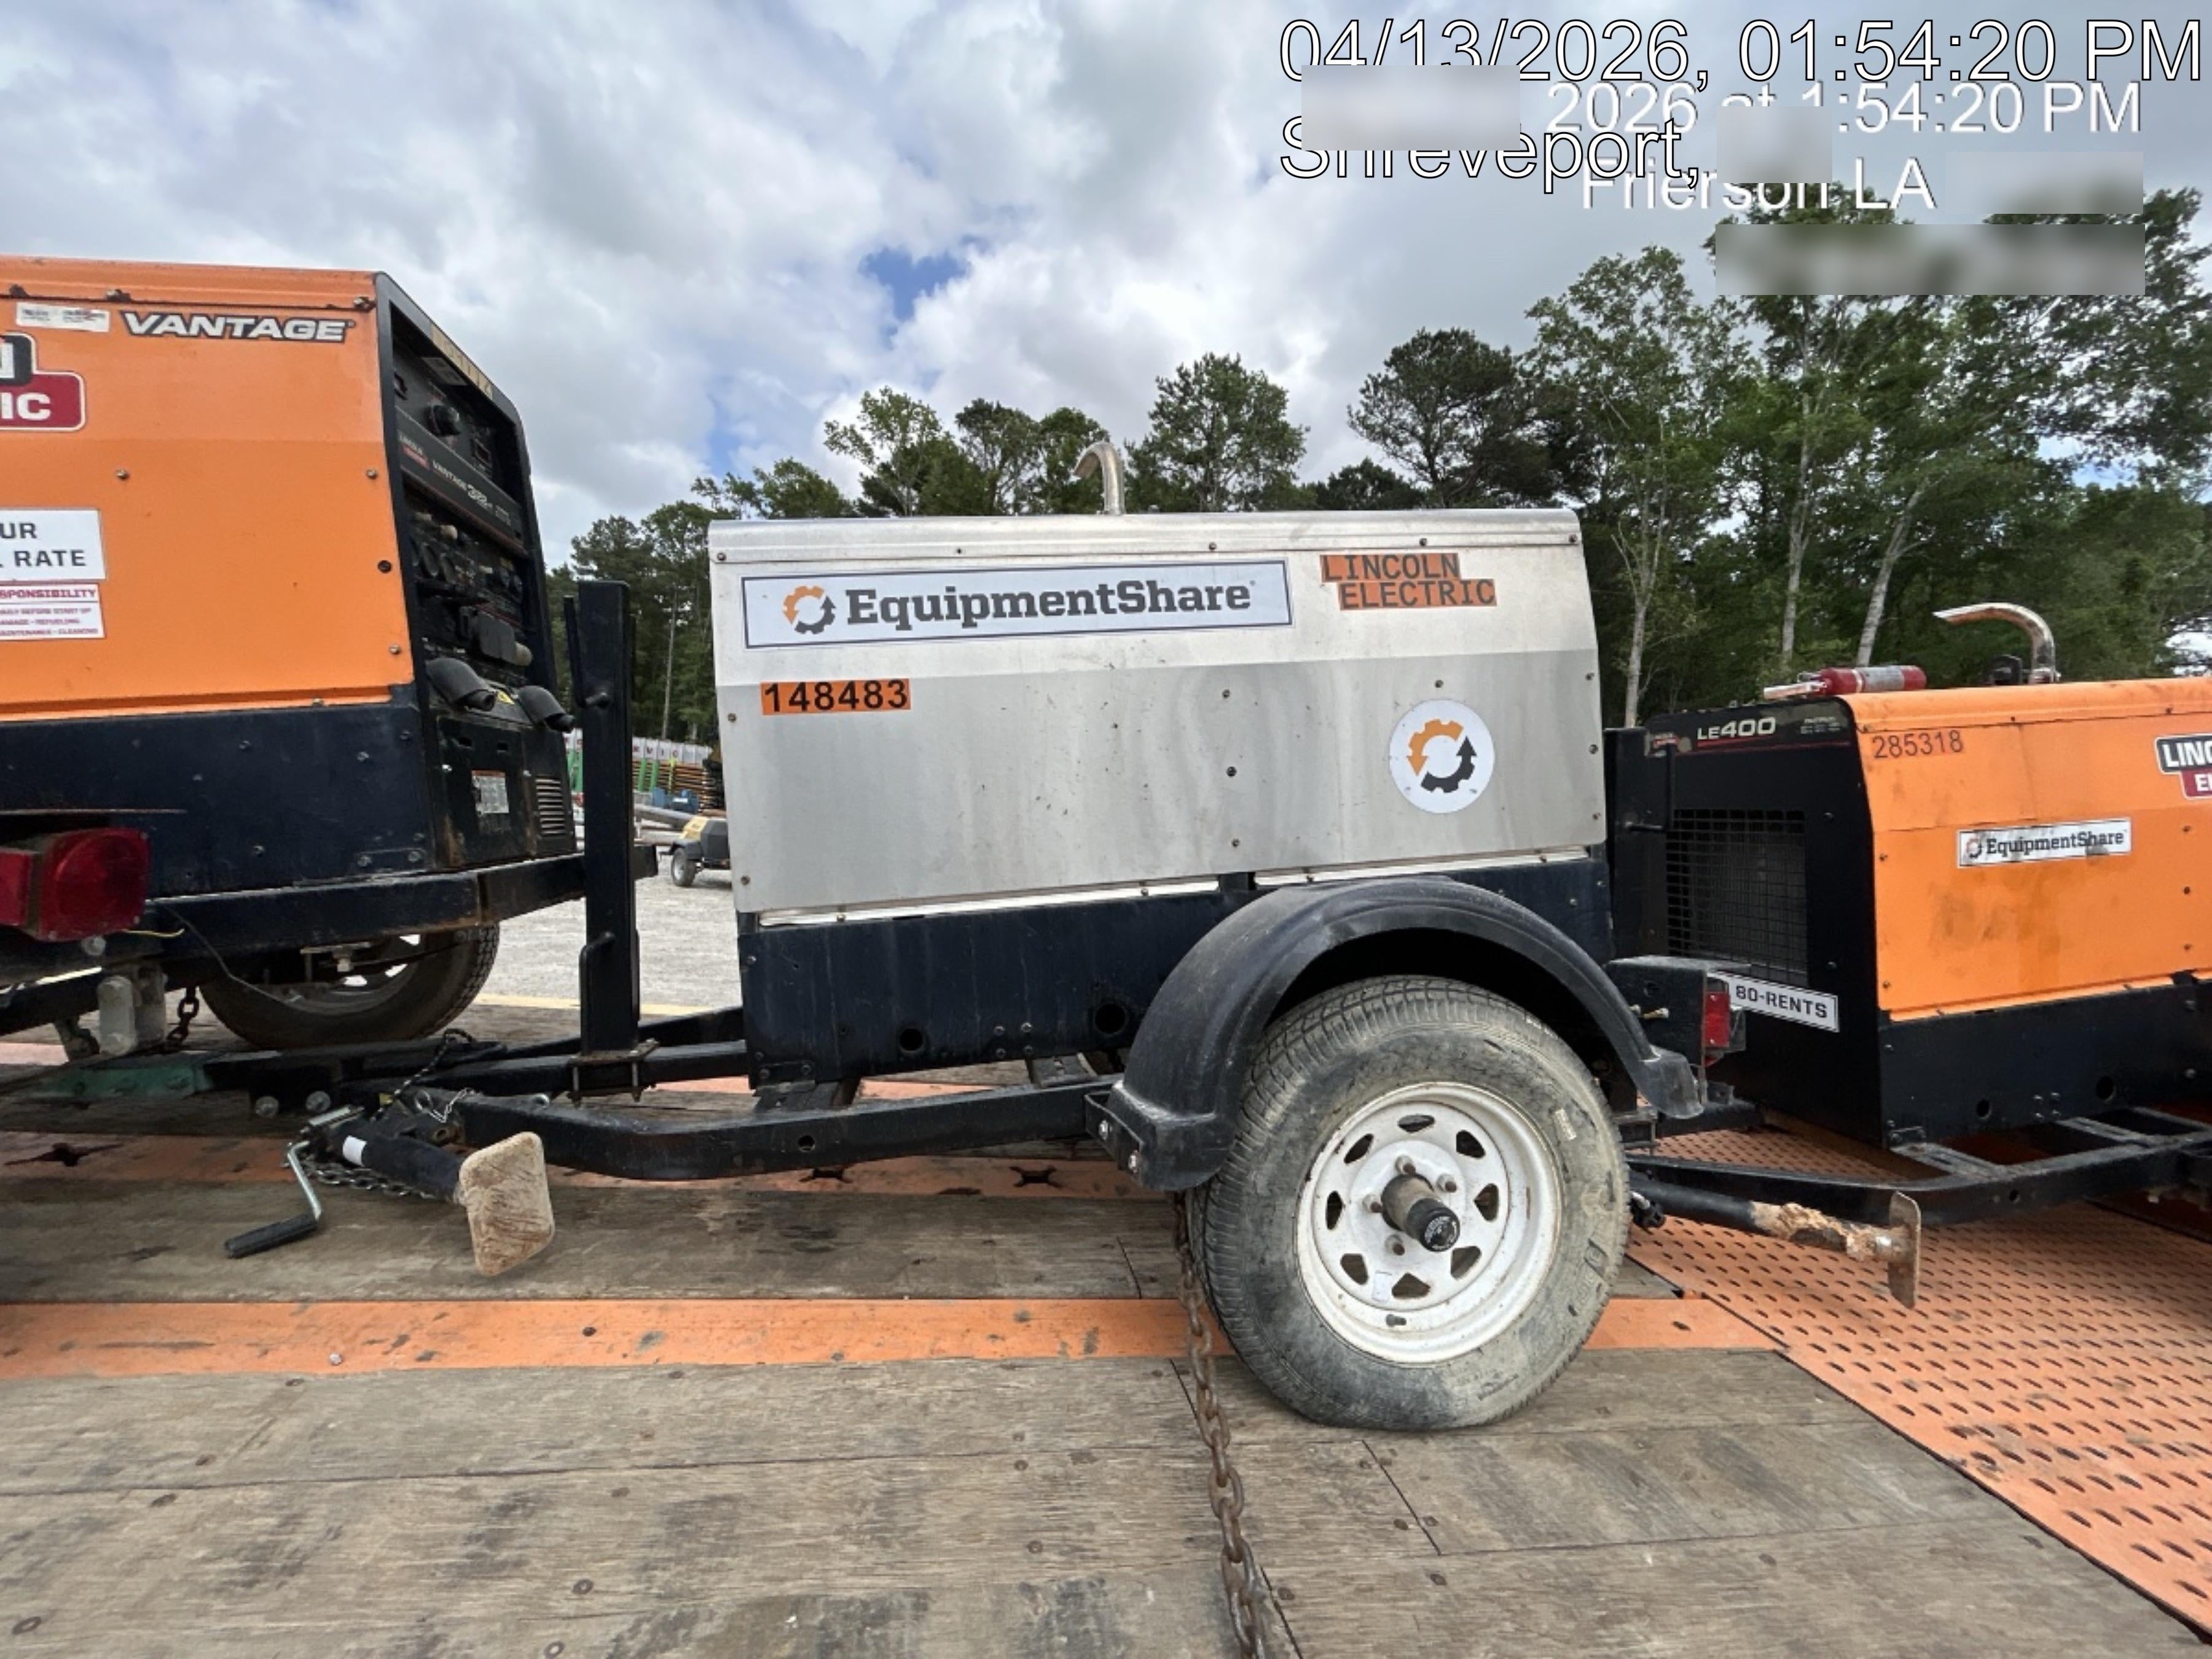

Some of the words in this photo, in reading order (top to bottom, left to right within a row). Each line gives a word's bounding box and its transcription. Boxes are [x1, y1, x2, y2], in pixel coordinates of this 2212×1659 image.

[123, 311, 348, 342] VANTAGE
[14, 549, 86, 568] RATE
[1323, 554, 1461, 581] LINCOLN
[845, 578, 1250, 632] EquipmentShare
[1340, 579, 1495, 608] ELECTRIC
[764, 680, 908, 712] 148483
[1698, 716, 1776, 740] LE400
[1872, 730, 1963, 758] 285318
[1986, 831, 2124, 857] EquipmentShare
[1736, 986, 1827, 1018] 80-RENTS
